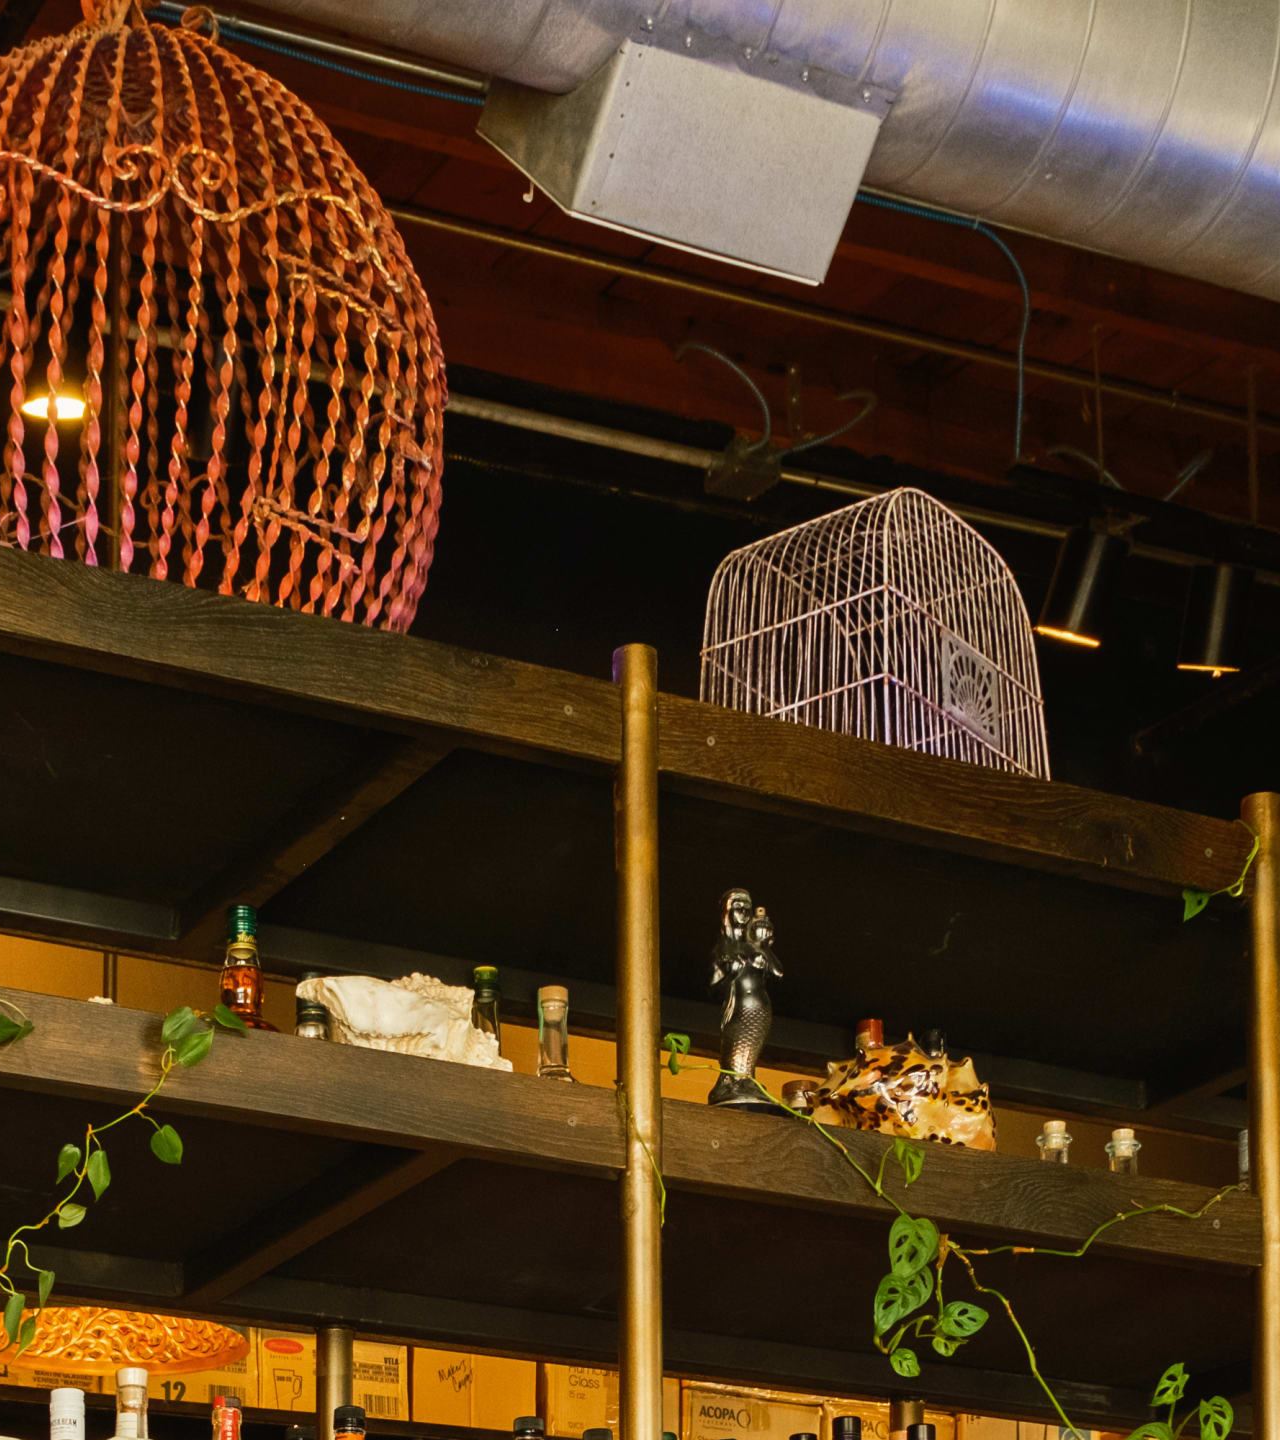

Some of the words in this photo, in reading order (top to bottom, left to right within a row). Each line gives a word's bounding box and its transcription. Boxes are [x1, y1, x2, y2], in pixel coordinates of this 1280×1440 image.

[569, 1375, 600, 1389] Glass
[161, 1381, 186, 1400] 12
[699, 1405, 736, 1421] ACOPA
